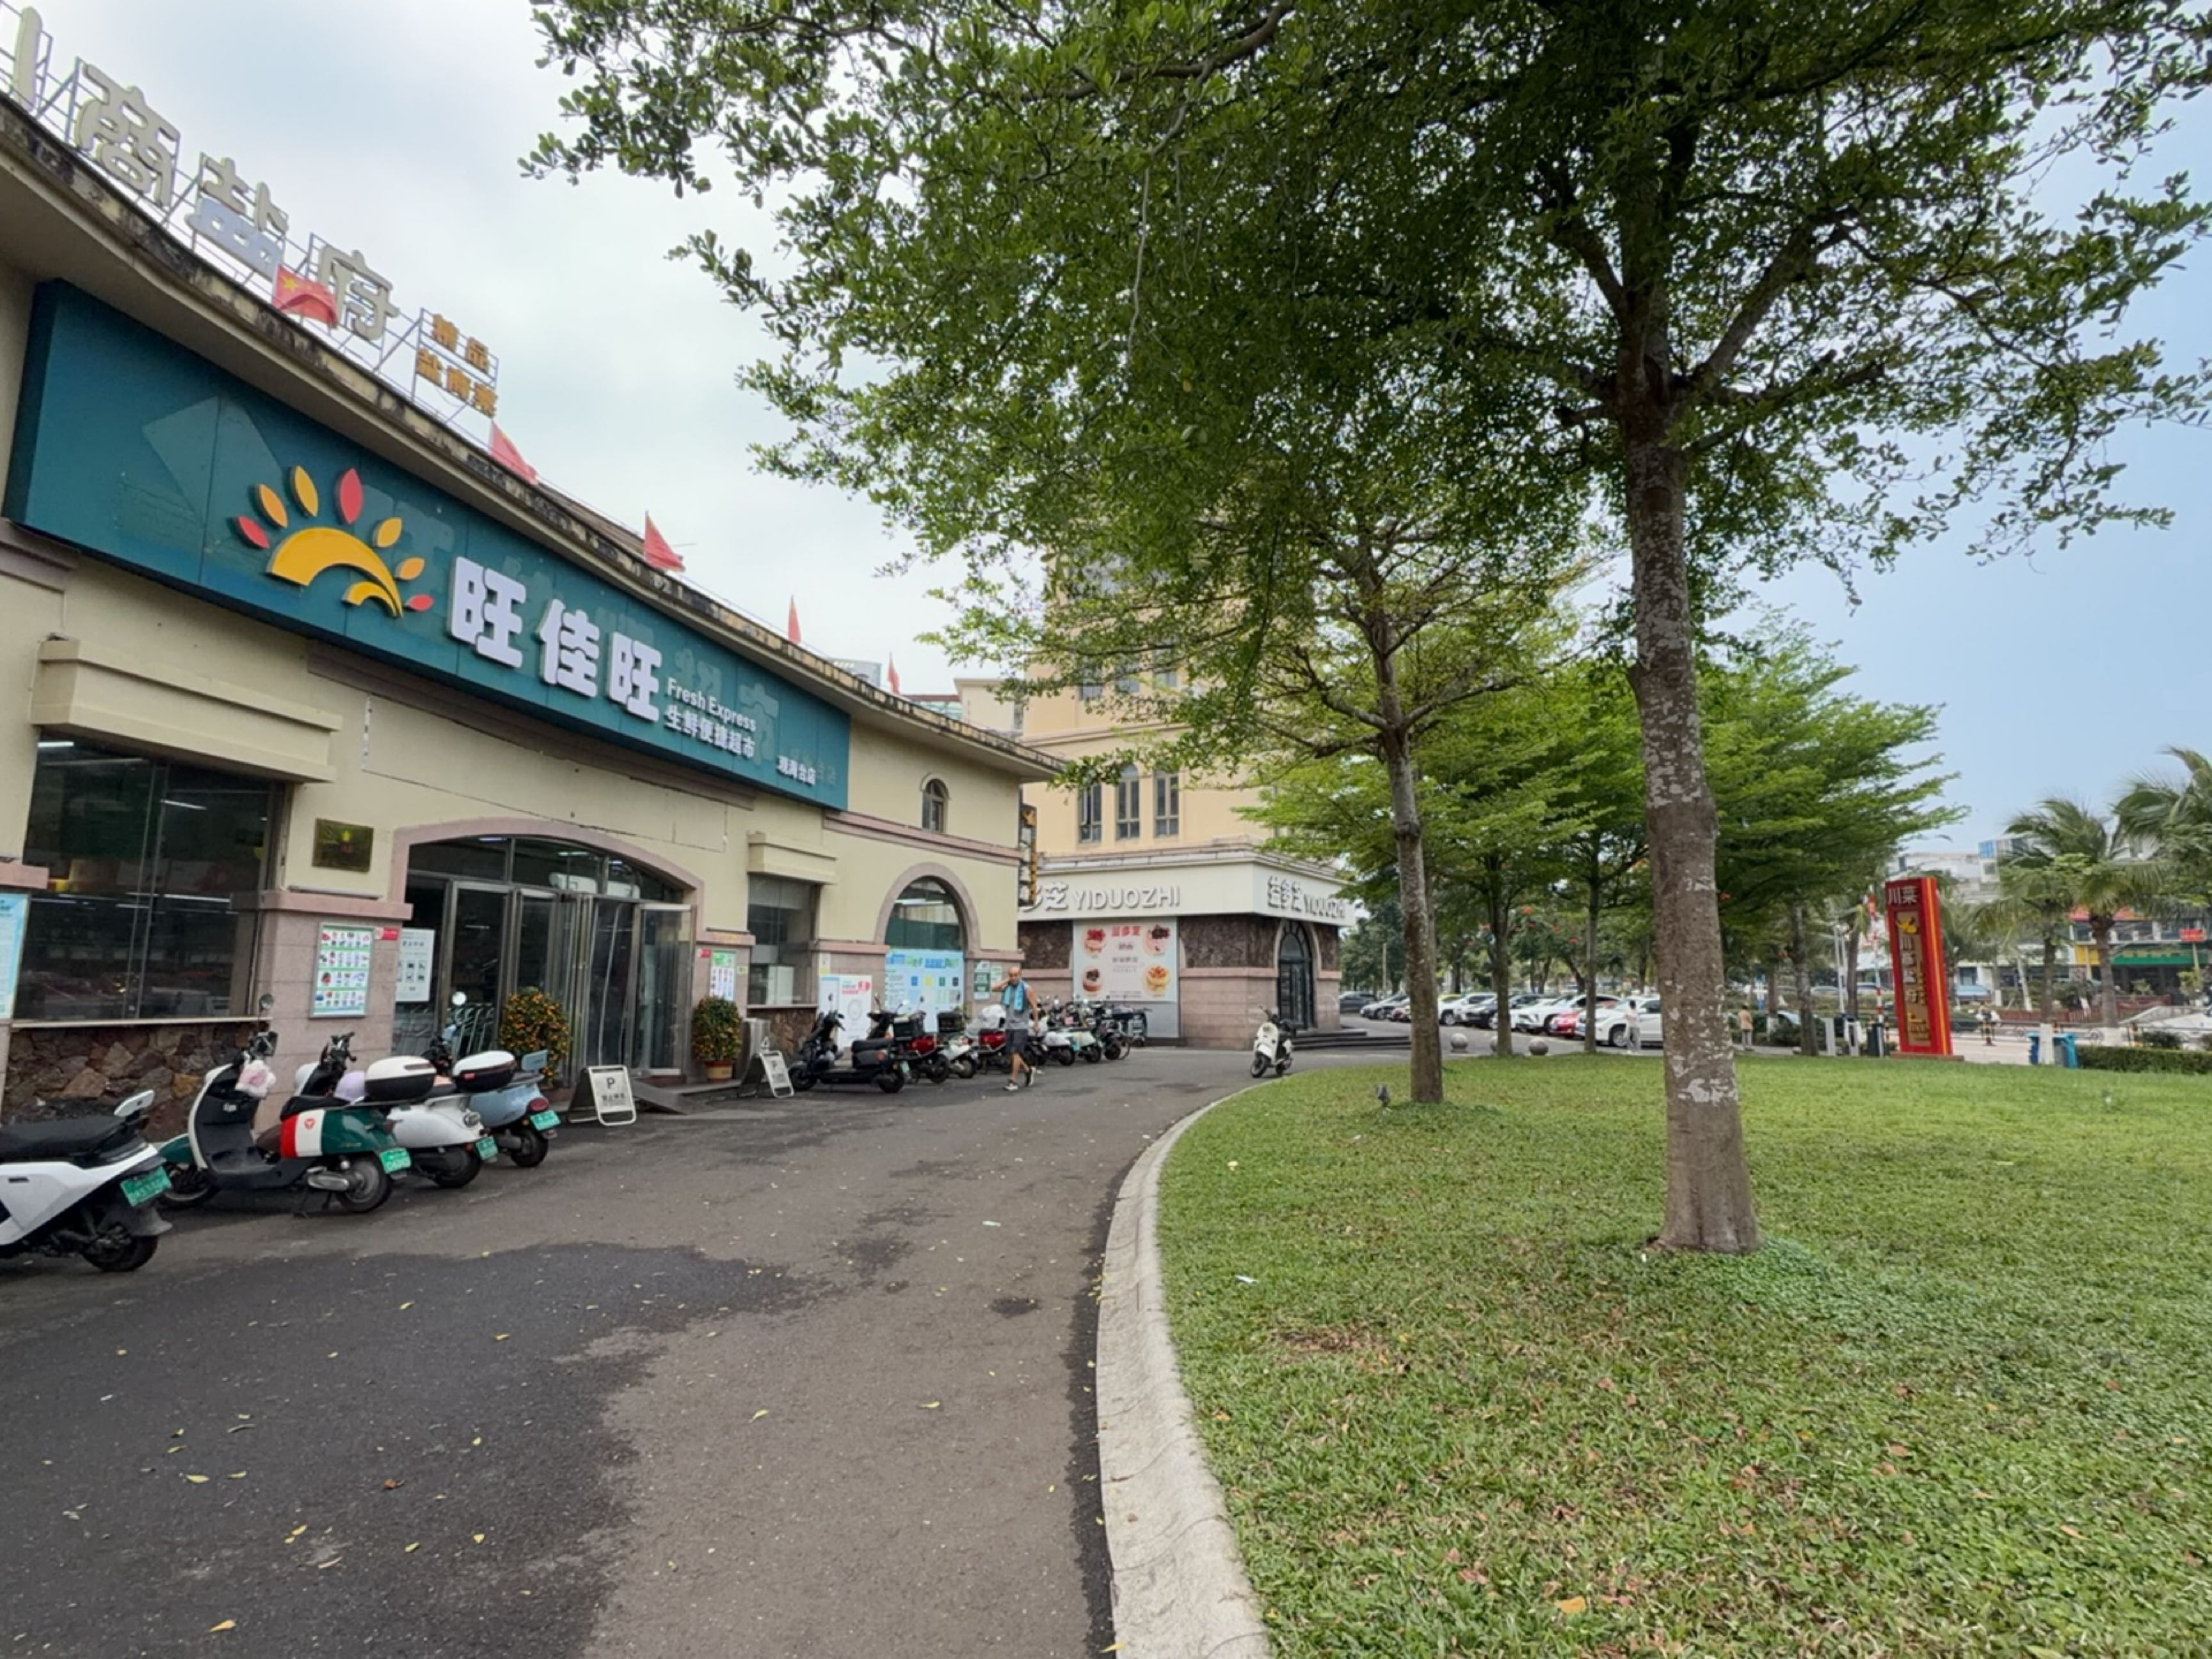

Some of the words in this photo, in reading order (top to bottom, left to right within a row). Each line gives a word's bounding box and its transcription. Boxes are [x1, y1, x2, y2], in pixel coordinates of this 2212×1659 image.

[451, 556, 662, 722] 旺佳旺
[666, 677, 706, 709] Fresh
[707, 694, 757, 733] Express
[664, 705, 756, 758] 生鲜便捷超市
[1073, 885, 1180, 911] YIDUOZHI
[1888, 885, 1918, 905] 川菜
[607, 1078, 615, 1089] P
